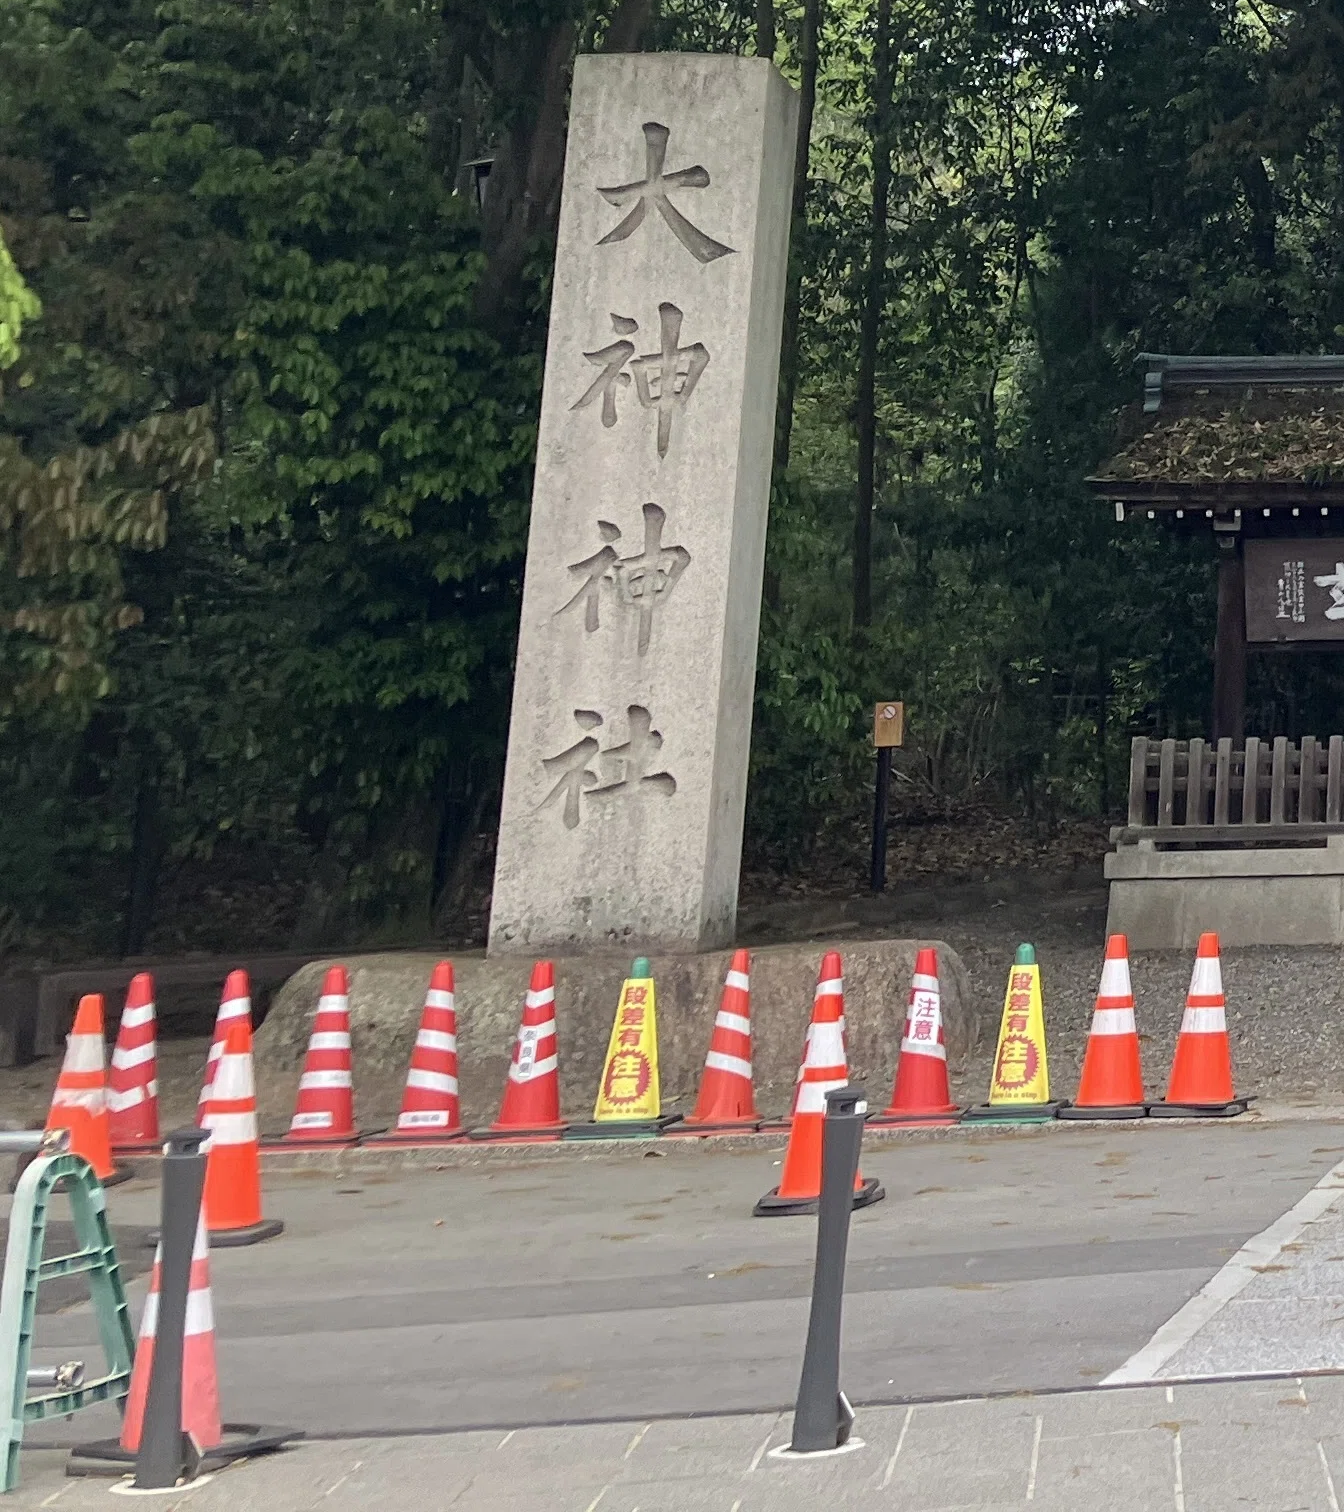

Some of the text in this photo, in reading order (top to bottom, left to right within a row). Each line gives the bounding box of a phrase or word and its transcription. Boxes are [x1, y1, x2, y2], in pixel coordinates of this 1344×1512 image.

[533, 120, 737, 830] 大神神社
[617, 986, 648, 1047] 段差有
[912, 997, 937, 1041] 注意
[1007, 972, 1033, 1032] 段差有
[609, 1055, 642, 1098] 注意
[1000, 1040, 1028, 1082] 注意
